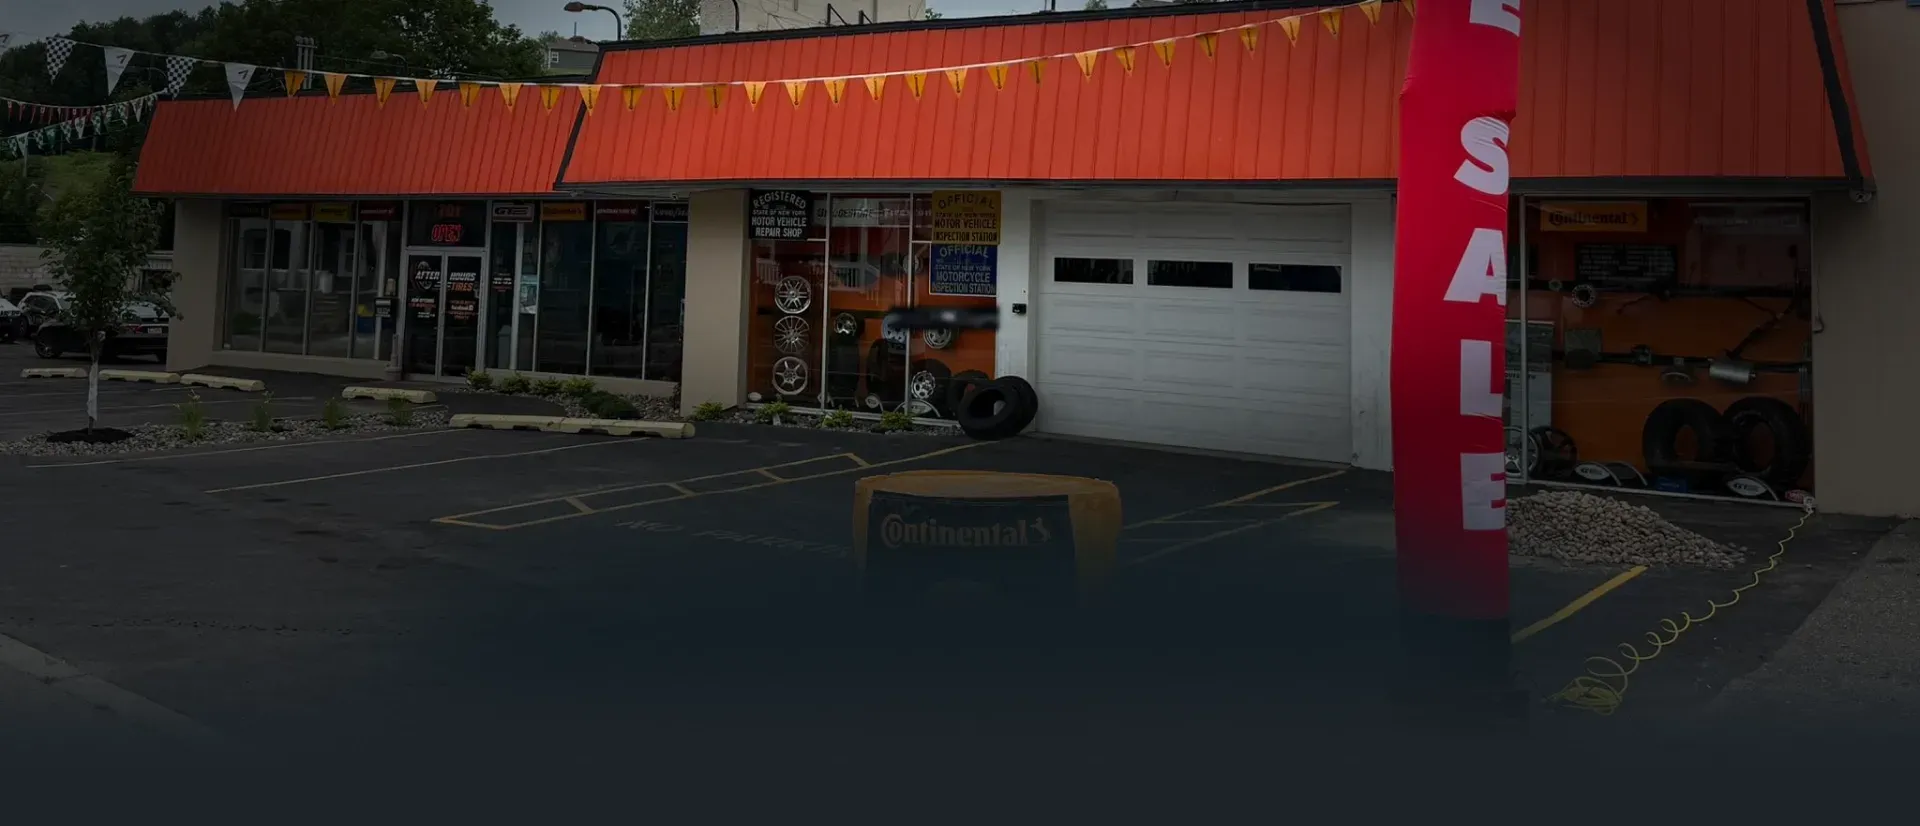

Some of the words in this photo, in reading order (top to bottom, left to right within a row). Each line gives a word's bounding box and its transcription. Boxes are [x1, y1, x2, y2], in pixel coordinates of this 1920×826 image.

[753, 191, 807, 209] REGISTERED
[938, 193, 995, 209] OFFICIAL
[752, 216, 775, 226] MOTOR
[777, 216, 807, 227] VEHICLE
[934, 219, 961, 229] MOTOR
[964, 219, 997, 229] VEHICLE
[432, 223, 463, 243] OPEN
[755, 227, 781, 237] REPAIR
[782, 227, 803, 238] SHOP
[933, 232, 970, 241] INSPECTION
[971, 232, 997, 242] STATION
[939, 245, 989, 258] OFFICIAL
[414, 271, 441, 280] AFTER
[449, 272, 477, 281] HOURS
[936, 271, 991, 283] MOTORCYCLE
[451, 282, 474, 292] TIRES
[970, 283, 996, 294] STATION
[1443, 116, 1511, 531] SALE
[611, 520, 686, 532] NO
[881, 513, 1028, 549] Continental
